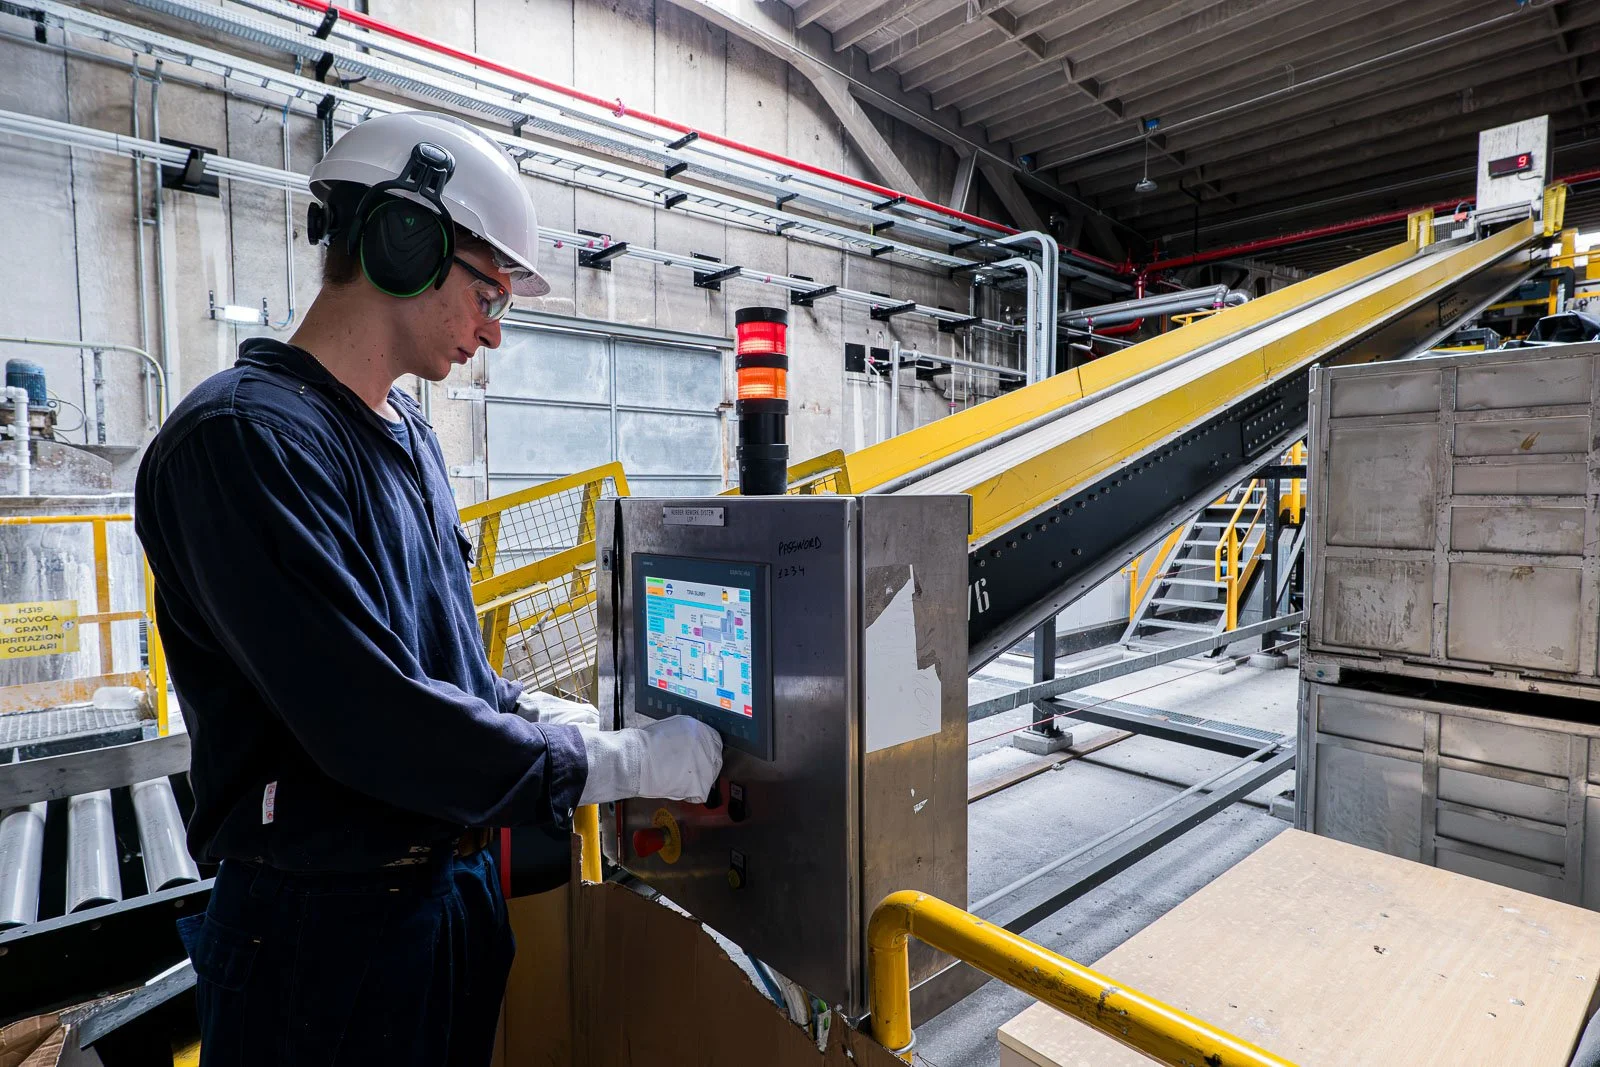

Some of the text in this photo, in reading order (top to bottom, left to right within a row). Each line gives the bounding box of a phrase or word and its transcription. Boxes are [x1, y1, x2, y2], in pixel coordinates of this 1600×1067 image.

[1518, 155, 1527, 168] 9
[778, 536, 822, 556] PASSWORD
[18, 606, 43, 614] H319
[3, 615, 59, 625] PROVOCA
[15, 624, 49, 634] GRAVI
[0, 633, 65, 645] IRRITAZIONI
[7, 643, 57, 654] OCULARI
